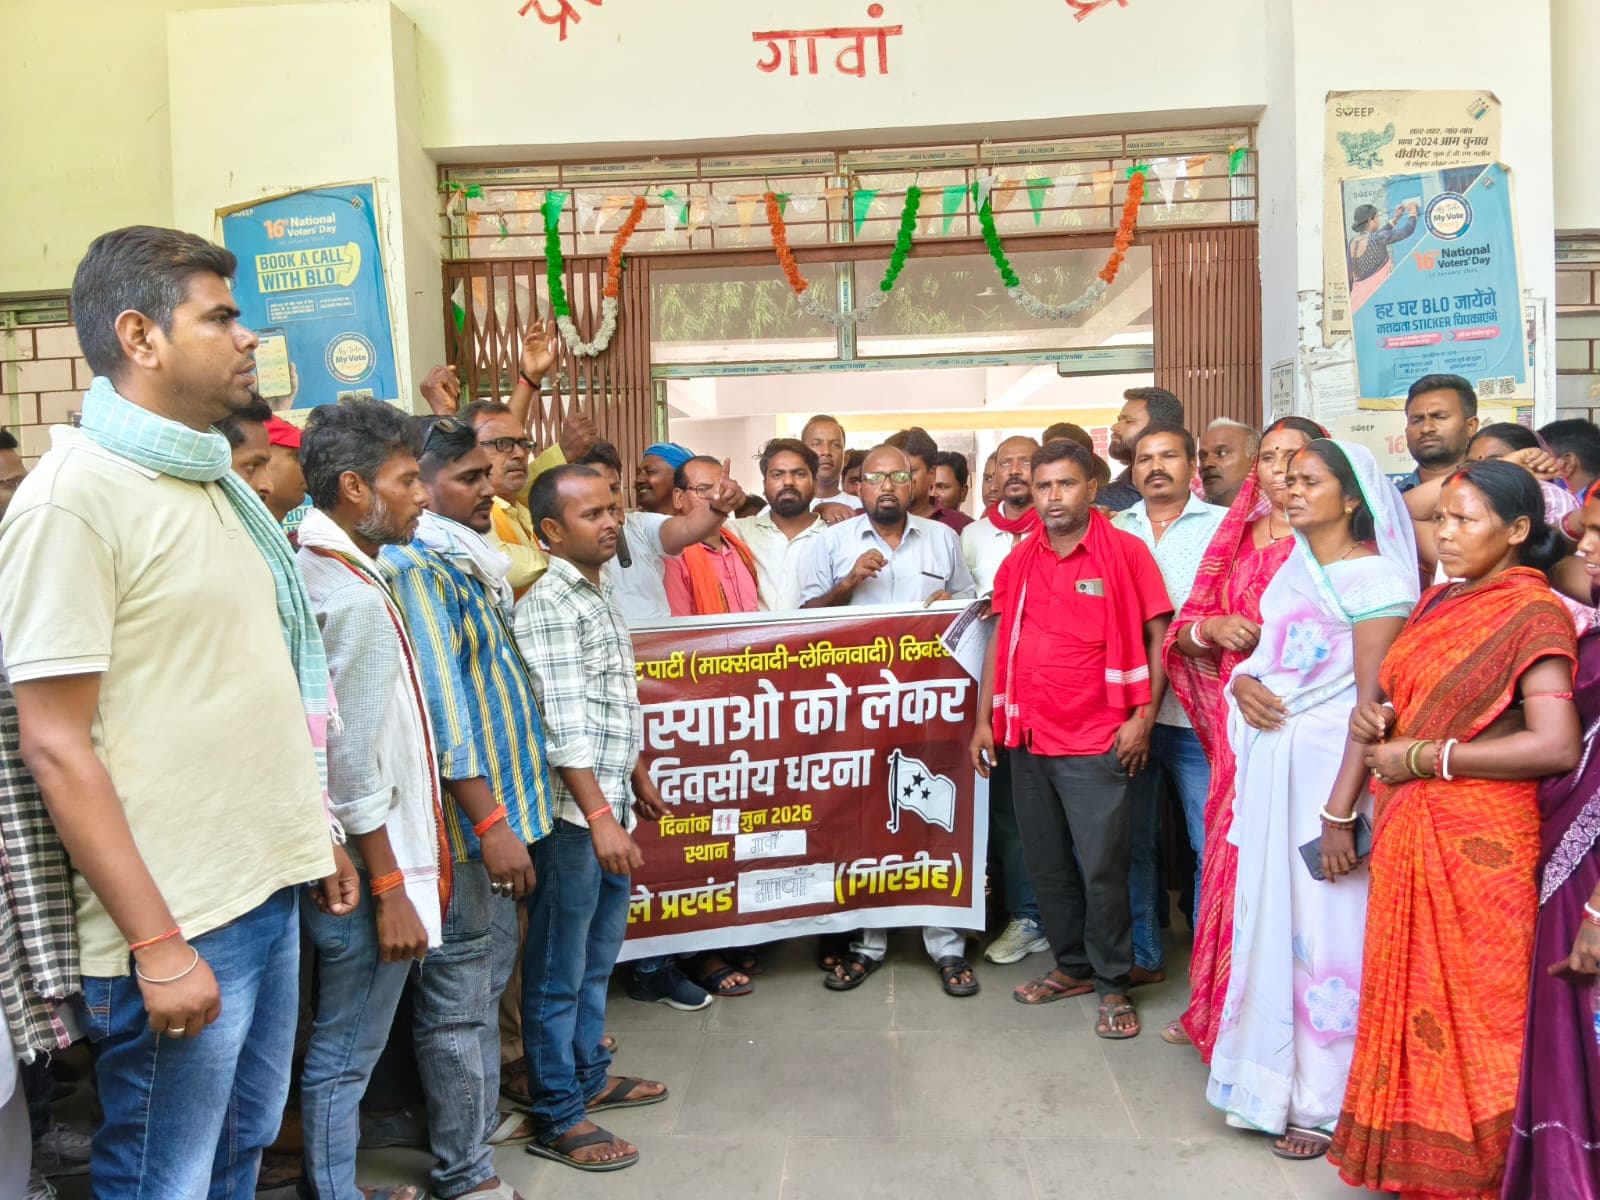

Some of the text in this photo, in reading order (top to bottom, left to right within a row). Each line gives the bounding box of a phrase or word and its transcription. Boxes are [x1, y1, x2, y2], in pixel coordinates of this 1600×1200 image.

[1335, 107, 1374, 117] SWEEP
[1415, 137, 1438, 146] 2024
[1440, 136, 1460, 146] आम
[1463, 136, 1488, 149] चुनाव
[290, 212, 336, 228] National
[1433, 214, 1446, 222] My
[319, 225, 336, 235] Day
[260, 248, 344, 270] BOOK A CALL
[1441, 243, 1490, 258] National
[1472, 256, 1491, 266] Day
[261, 267, 335, 290] WITH BLO
[1374, 302, 1394, 320] हर
[1397, 300, 1418, 316] घर
[1422, 296, 1449, 314] BLO
[1375, 320, 1411, 334] मतदाता
[1412, 316, 1451, 331] STICKER
[335, 354, 367, 364] My Vote
[1351, 424, 1375, 432] SWEEP
[646, 650, 686, 679] पार्टी
[899, 634, 952, 662] लिबरे
[639, 668, 971, 751] स्याओ को लेकर
[648, 748, 875, 805] दिवसीय धरना
[658, 813, 711, 838] दिनांक
[716, 813, 732, 832] 11
[771, 804, 813, 824] 2026
[684, 842, 730, 864] स्थान
[658, 877, 736, 920] प्रखंड
[834, 850, 963, 905] (गिरिडीह)
